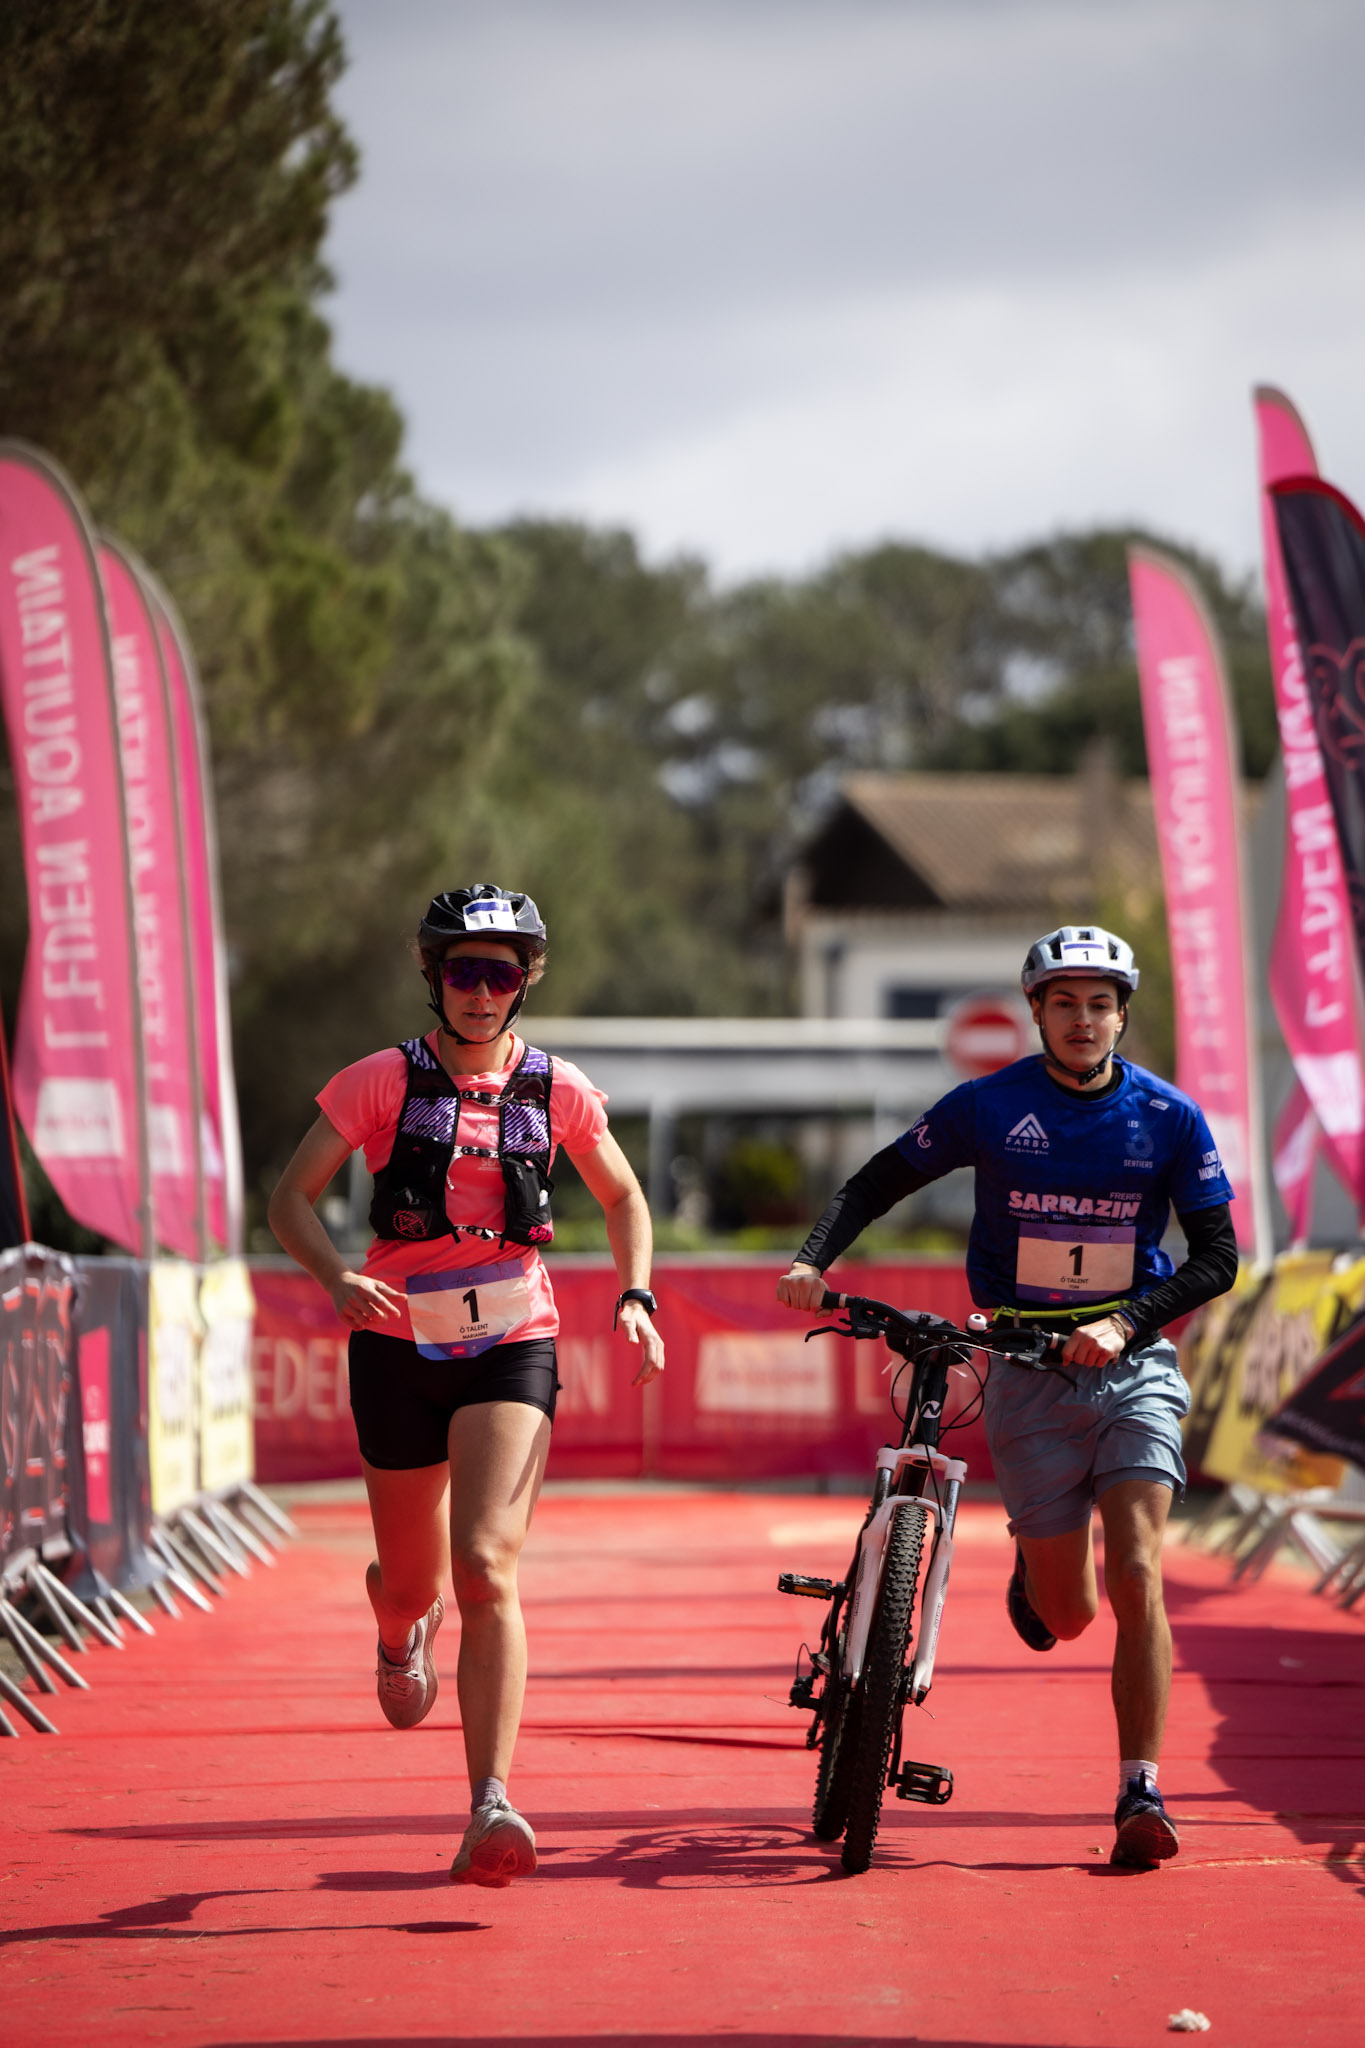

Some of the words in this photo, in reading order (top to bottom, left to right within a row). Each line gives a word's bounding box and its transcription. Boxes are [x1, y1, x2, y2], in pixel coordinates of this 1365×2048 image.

[1083, 950, 1089, 961] 1
[1127, 1120, 1139, 1128] LES
[1005, 1137, 1049, 1149] FARBO
[1123, 1160, 1153, 1169] SENTIERS
[1008, 1190, 1140, 1219] SARRAZIN
[1069, 1245, 1083, 1276] 1
[462, 1288, 480, 1323] 1
[466, 1323, 489, 1333] TALENT
